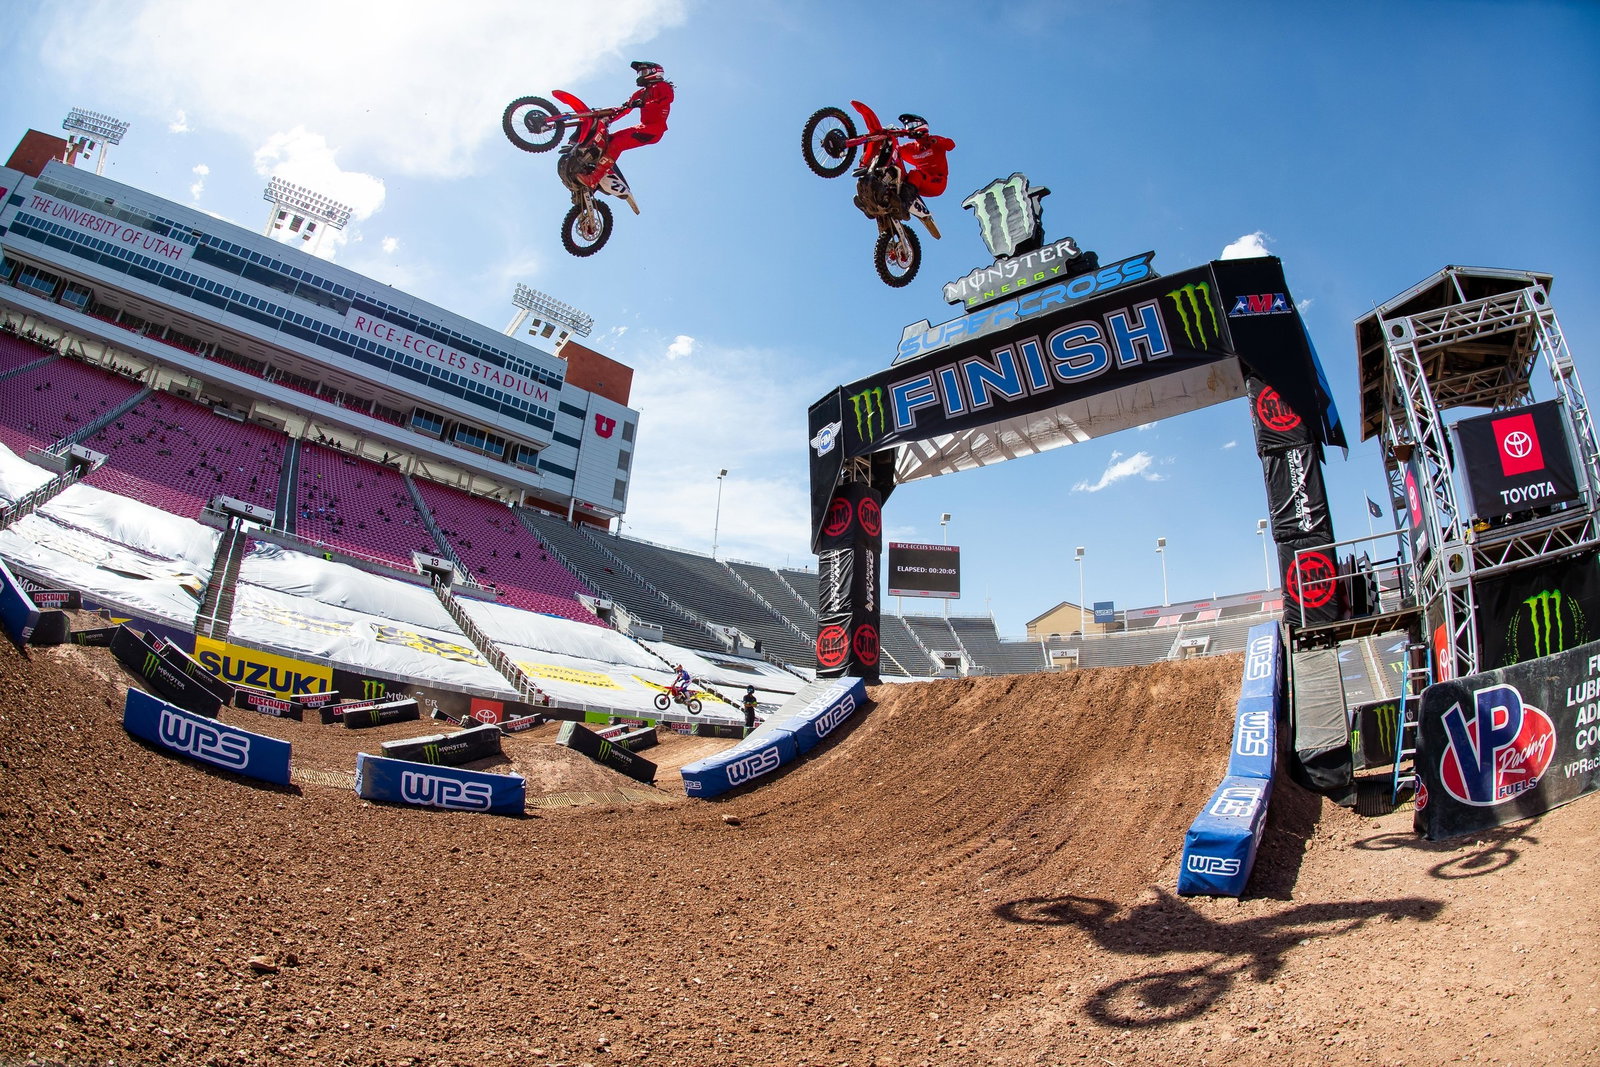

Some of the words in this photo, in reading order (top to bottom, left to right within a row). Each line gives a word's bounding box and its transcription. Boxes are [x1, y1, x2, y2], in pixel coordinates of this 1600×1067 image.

[30, 195, 52, 213] THE
[51, 200, 123, 241] UNIVERSITY
[121, 228, 144, 246] OF
[142, 234, 184, 261] UTAH
[947, 240, 1077, 298] MONSTER
[968, 265, 1061, 305] ENERGY
[898, 256, 1150, 360] SUPERCROSS
[1228, 293, 1291, 315] AMA
[354, 315, 467, 370] RICE-ECCLES
[471, 361, 550, 403] STADIUM
[887, 298, 1174, 433] FINISH
[594, 412, 616, 439] U
[84, 450, 91, 459] 11
[1287, 451, 1299, 492] MOUNTAIN
[1501, 481, 1556, 505] TOYOTA
[244, 504, 253, 513] 12
[430, 557, 439, 567] 13
[897, 565, 928, 573] ELAPSED:
[928, 567, 956, 575] 00:20:05
[34, 592, 70, 602] DISCOUNT
[1246, 635, 1273, 680] WPS
[199, 650, 328, 695] SUZUKI
[248, 695, 292, 712] DISCOUNT
[259, 706, 280, 716] TIRE
[300, 695, 331, 703] DISCOUNT
[507, 717, 535, 729] DISCOUNT
[621, 718, 643, 726] DISCOUNT
[671, 722, 691, 730] DISCO
[815, 694, 856, 738] WPS
[159, 710, 250, 769] WPS
[439, 742, 468, 753] MONSTER
[1236, 711, 1269, 756] WPS
[1440, 684, 1523, 802] VP
[726, 746, 780, 785] WPS
[1498, 730, 1554, 786] Racing
[402, 770, 492, 811] WPS
[1498, 777, 1538, 798] FUELS
[1209, 787, 1261, 817] WPS
[1187, 855, 1241, 876] WPS
